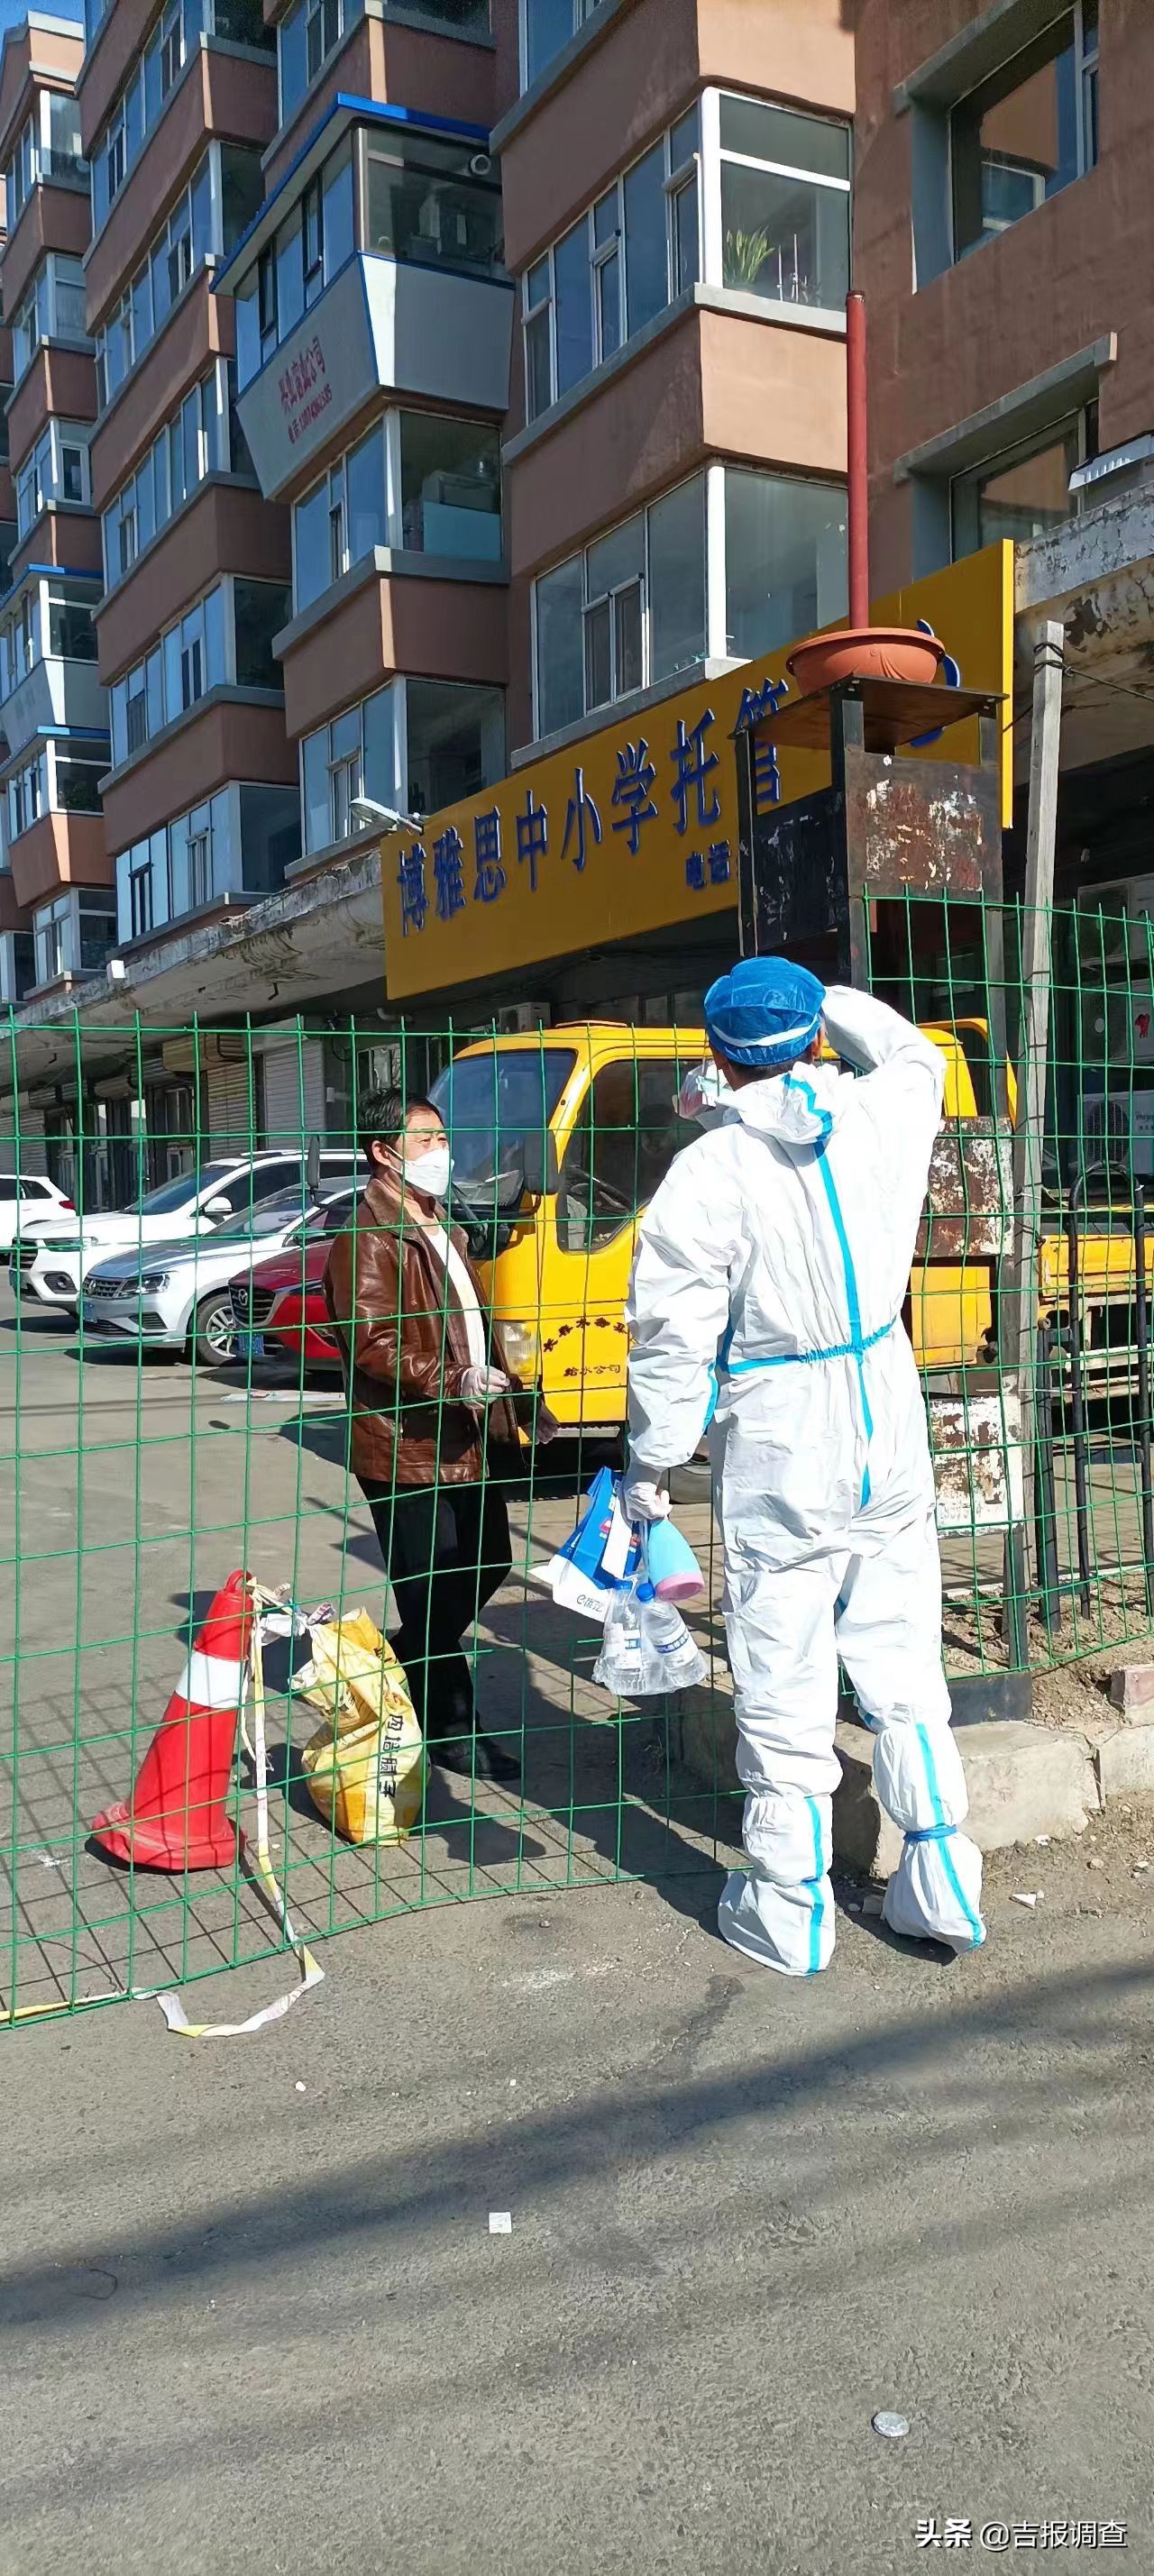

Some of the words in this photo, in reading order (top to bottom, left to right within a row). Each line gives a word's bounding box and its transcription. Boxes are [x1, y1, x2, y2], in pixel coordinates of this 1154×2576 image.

[398, 618, 961, 937] 博雅思中小学托管
[686, 838, 730, 890] 电话
